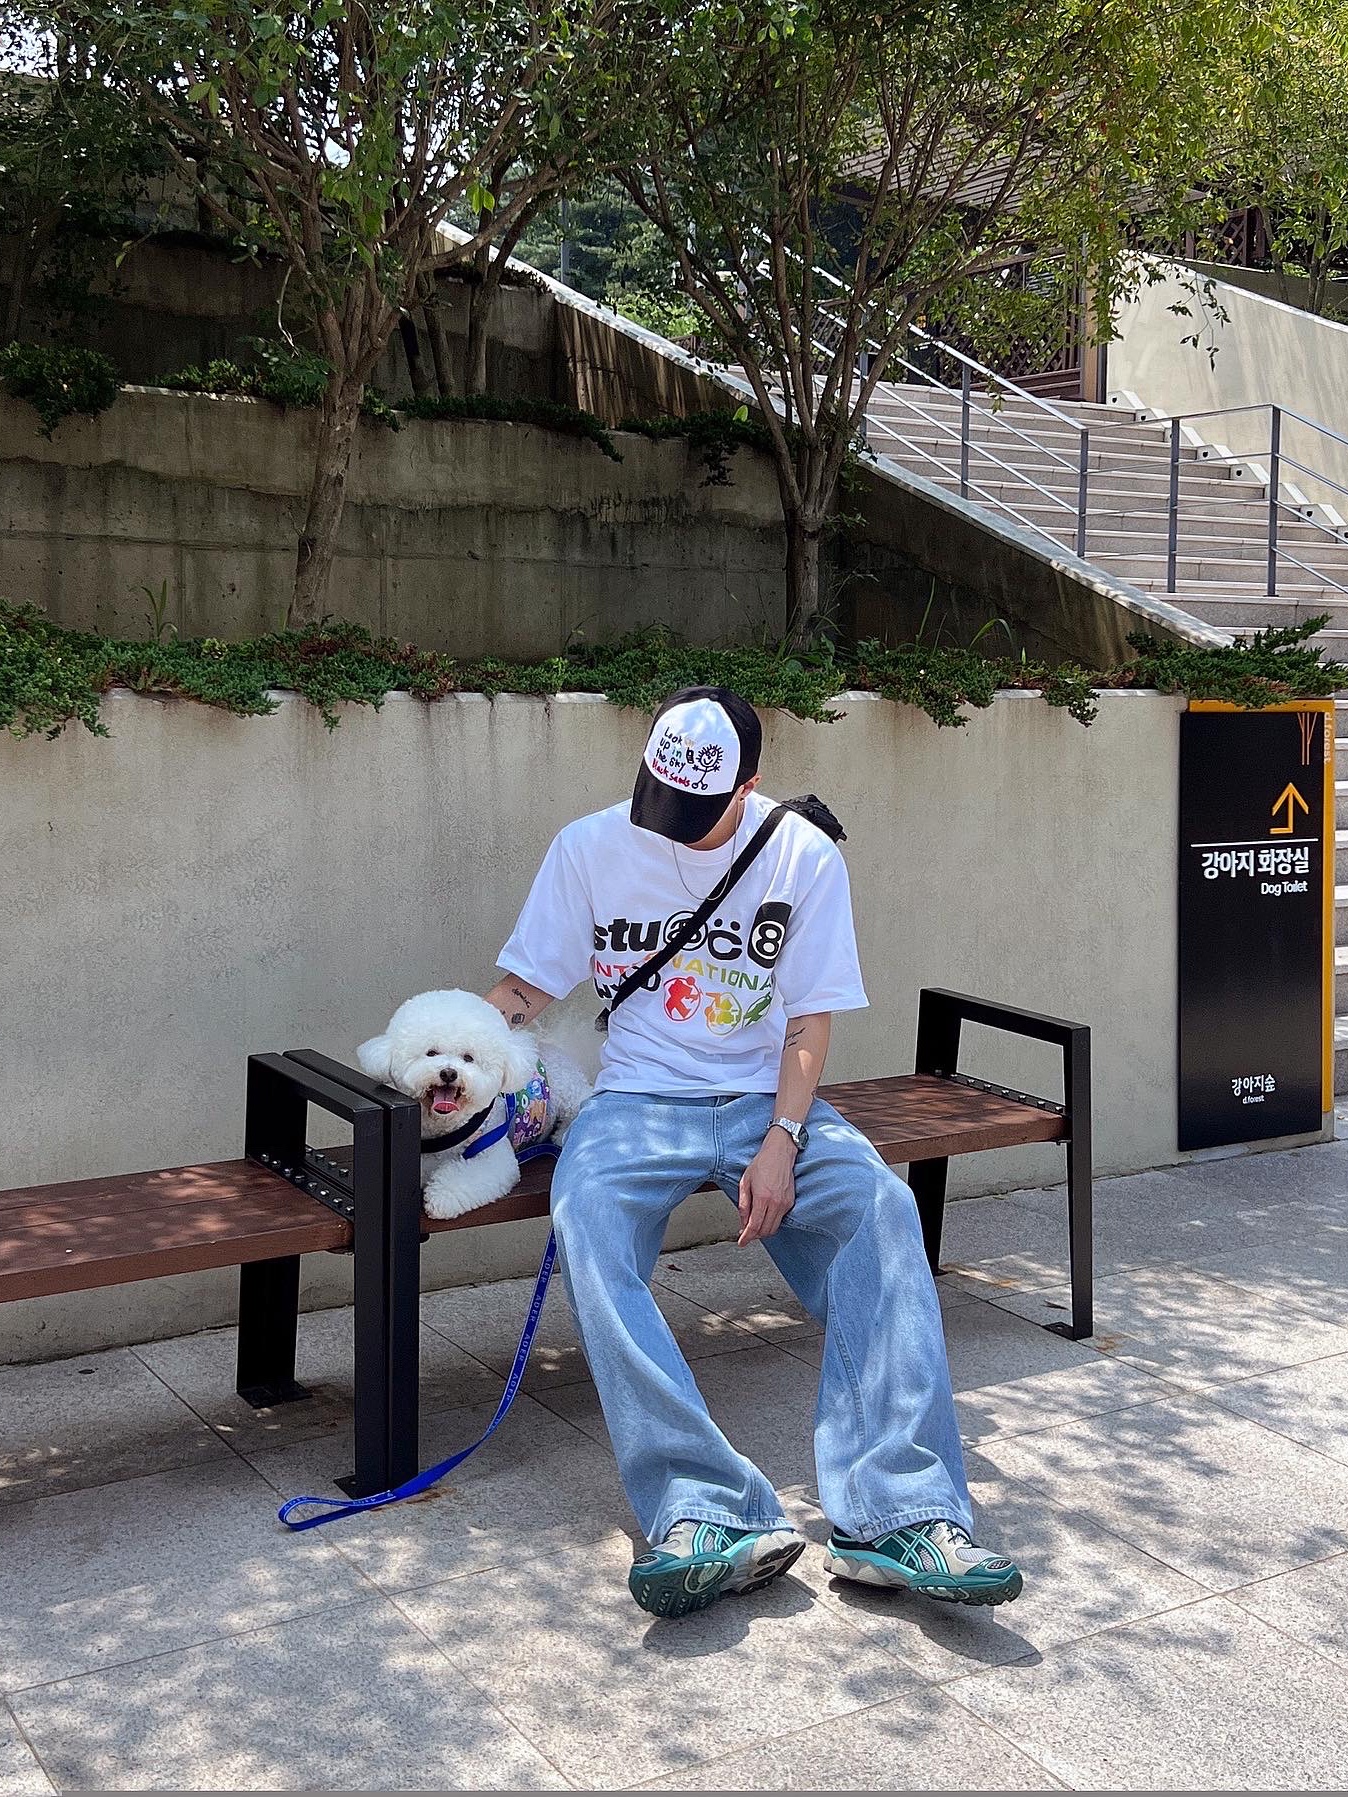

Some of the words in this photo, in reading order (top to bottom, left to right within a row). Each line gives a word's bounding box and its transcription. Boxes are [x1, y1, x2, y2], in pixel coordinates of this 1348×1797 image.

[664, 726, 683, 746] Look
[1201, 850, 1255, 879] 강아지
[1257, 847, 1309, 876] 화장실
[1261, 882, 1281, 896] Dog
[1282, 880, 1308, 893] Toilet
[1231, 1074, 1276, 1096] 강아지숲
